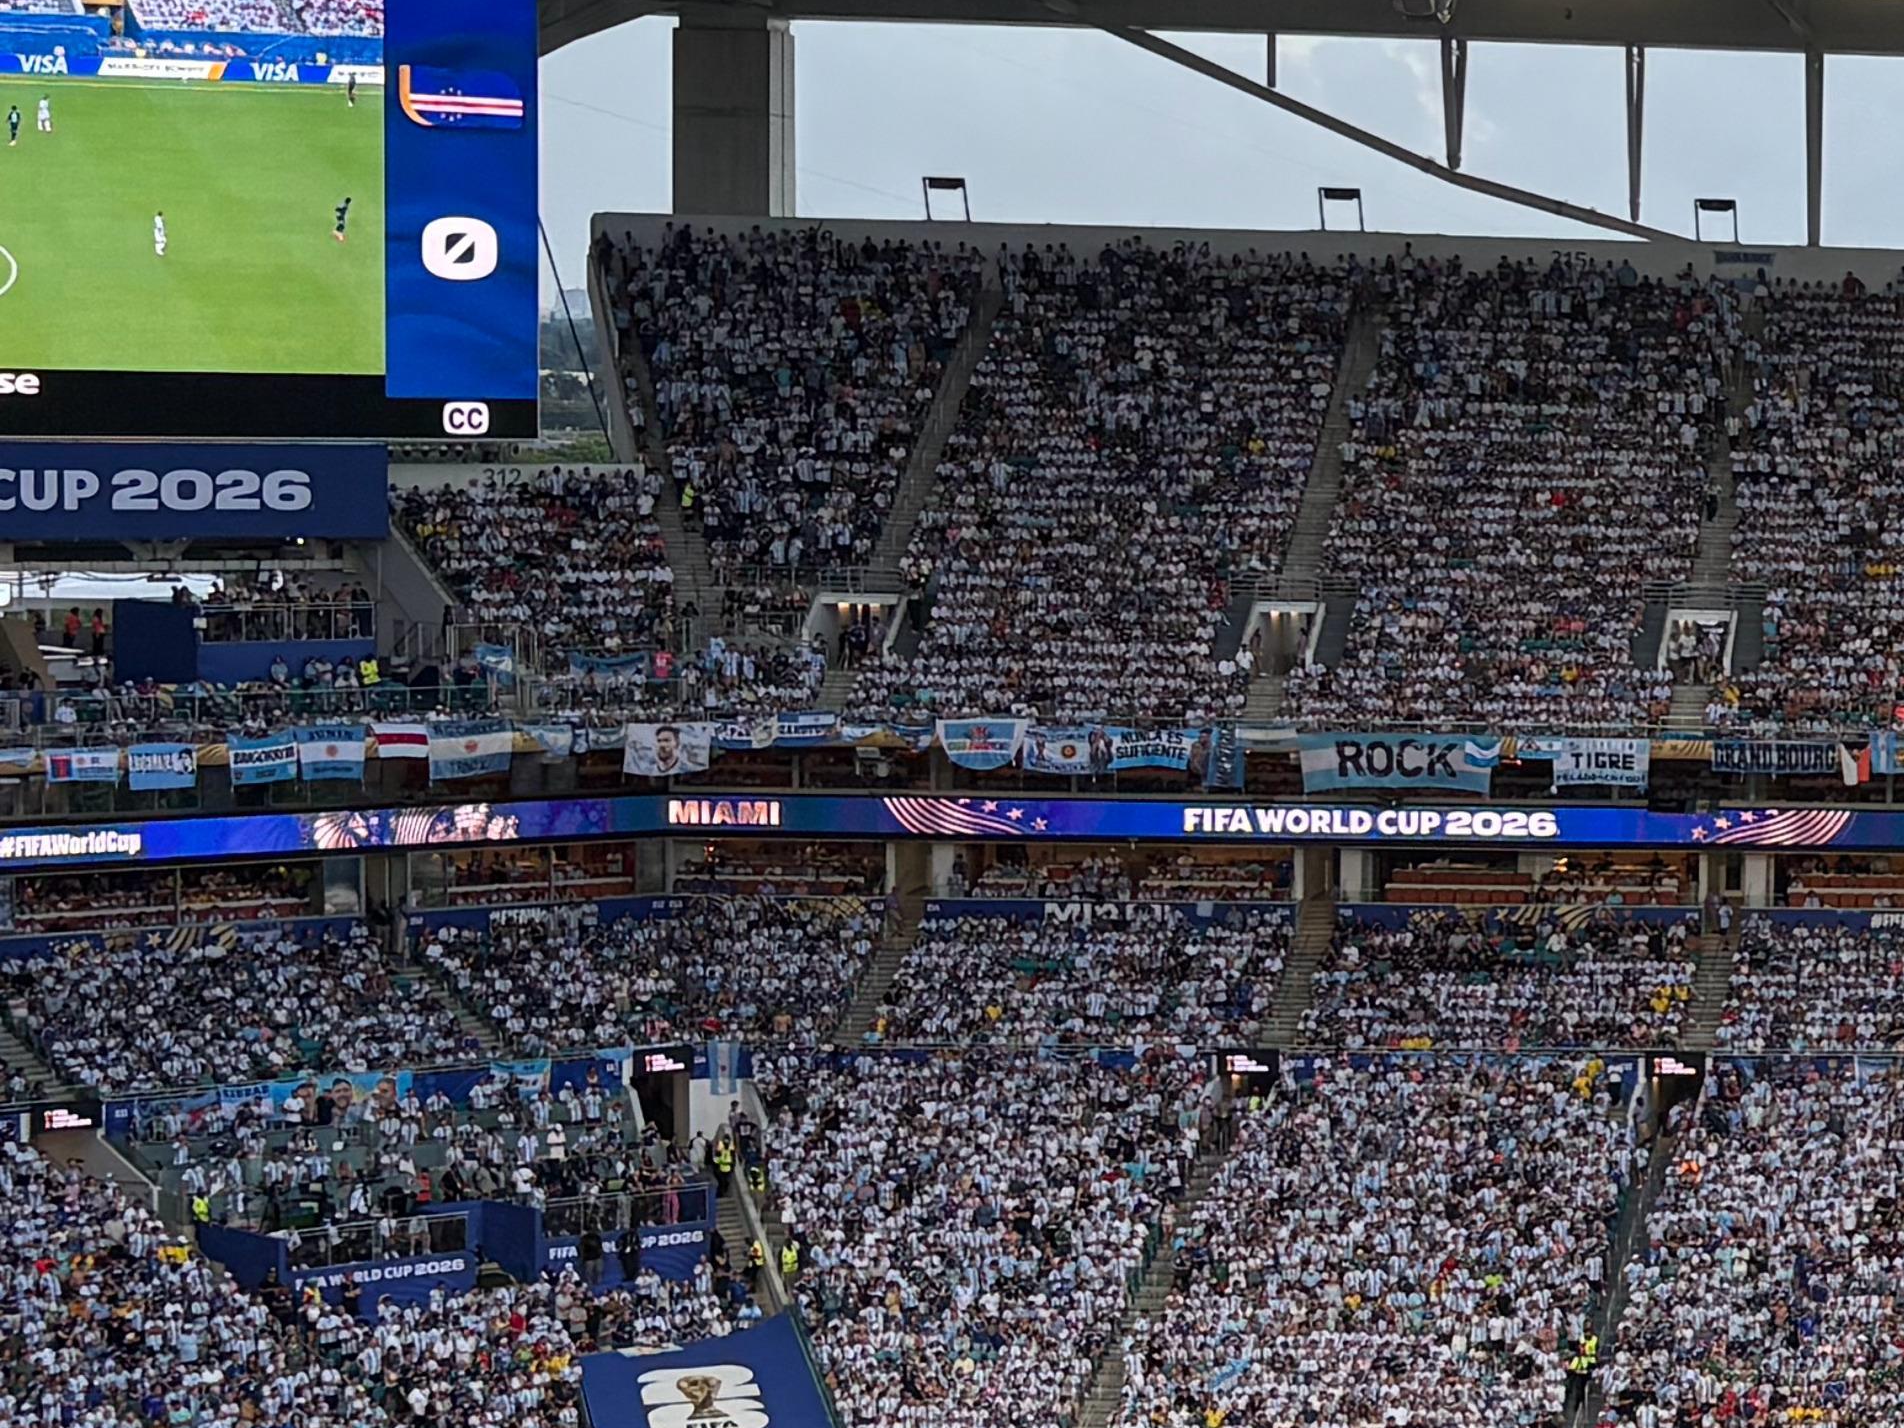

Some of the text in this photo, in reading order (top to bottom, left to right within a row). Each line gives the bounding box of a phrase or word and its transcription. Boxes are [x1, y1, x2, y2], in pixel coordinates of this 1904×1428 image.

[251, 62, 300, 82] VISA
[422, 217, 498, 281] 0
[447, 407, 485, 430] CC
[110, 469, 313, 512] 2026
[482, 467, 522, 489] 312
[1334, 739, 1460, 779] ROCK
[1570, 752, 1636, 772] TIGRE
[668, 800, 781, 826] MIAMI
[1183, 807, 1558, 837] FIFA WORLD CUP 2026
[549, 1245, 579, 1260] FIFA
[657, 1230, 704, 1247] 2026
[384, 1264, 413, 1279] CUP
[414, 1258, 465, 1276] 2026
